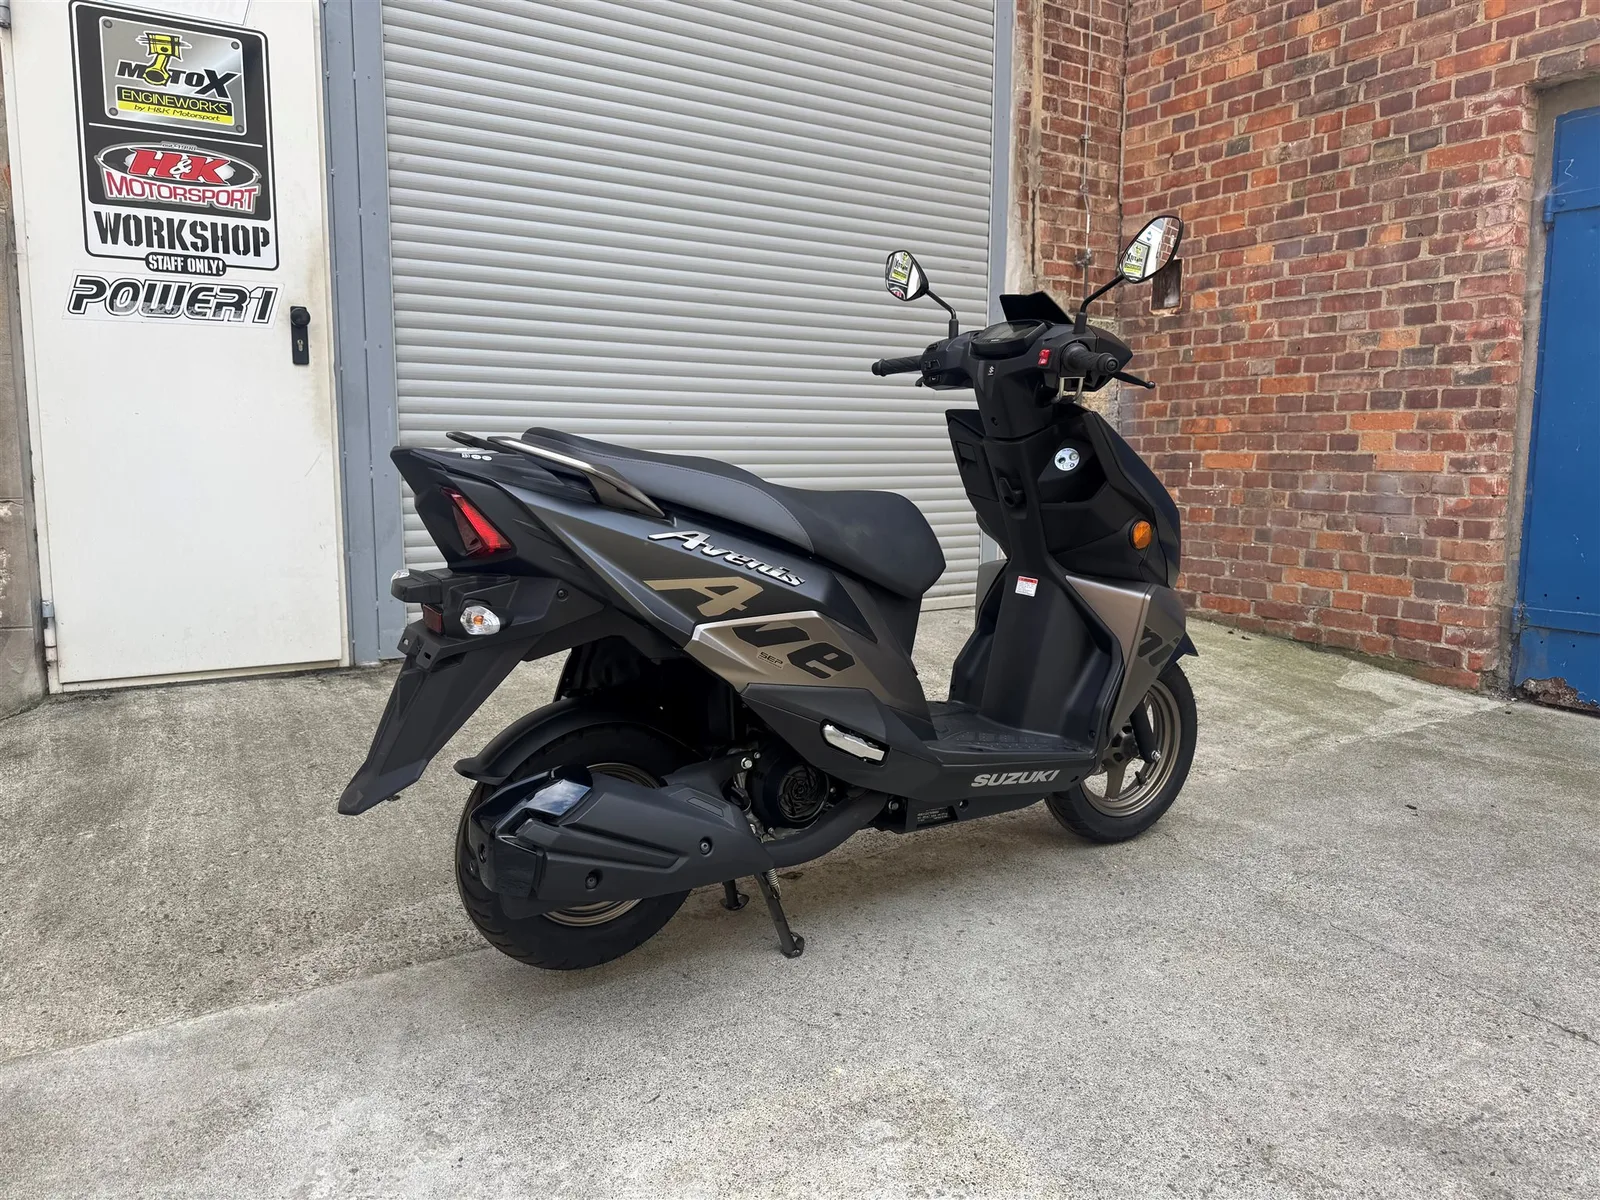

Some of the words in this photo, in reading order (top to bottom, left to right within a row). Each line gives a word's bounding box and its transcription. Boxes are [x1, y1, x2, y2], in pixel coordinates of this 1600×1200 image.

[121, 89, 228, 114] ENGINEWORKS
[134, 104, 145, 112] by
[147, 106, 170, 115] H&K
[172, 109, 220, 121] Motorsport
[127, 148, 231, 185] H&K
[105, 171, 258, 210] MOTORSPORT
[93, 211, 270, 257] WORKSHOP
[148, 255, 184, 272] STAFF
[187, 258, 223, 275] ONLY!
[68, 274, 279, 324] POWER1
[648, 530, 806, 587] Avenis
[760, 651, 783, 665] SEP
[970, 769, 1061, 788] SUZUKI
